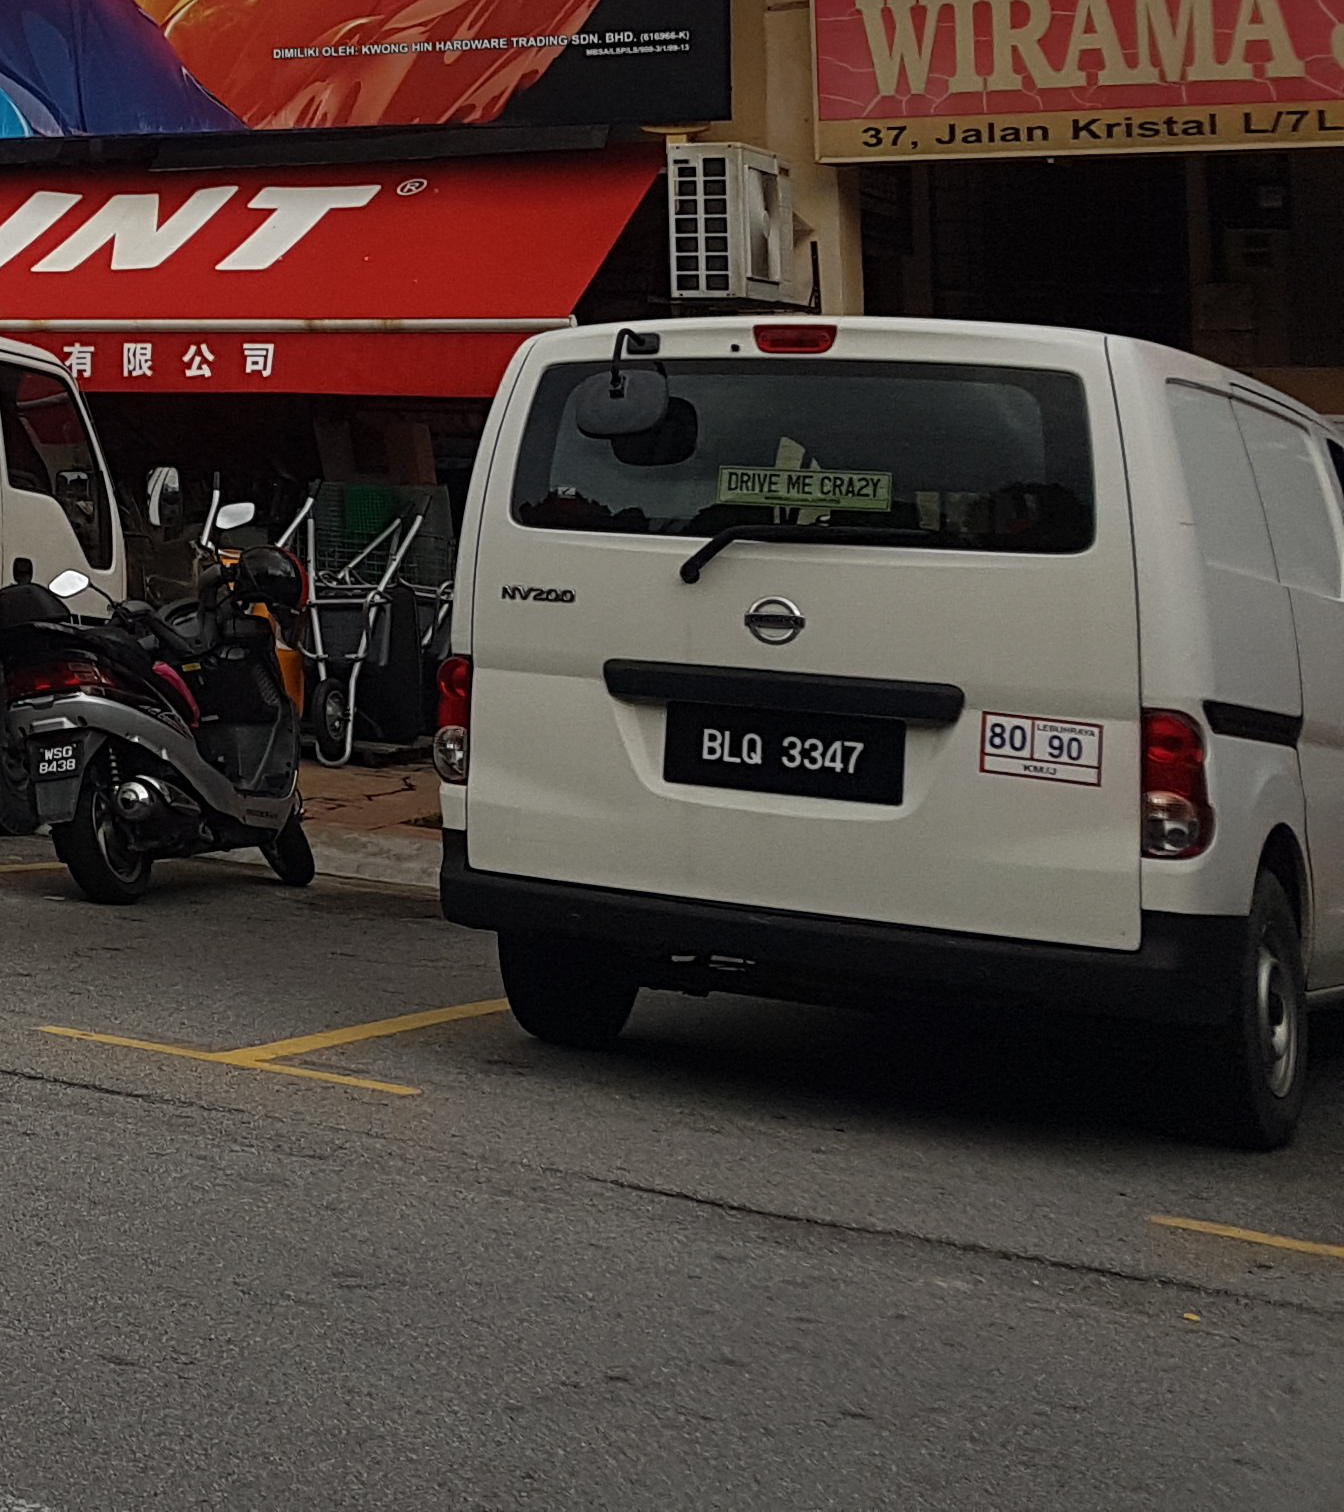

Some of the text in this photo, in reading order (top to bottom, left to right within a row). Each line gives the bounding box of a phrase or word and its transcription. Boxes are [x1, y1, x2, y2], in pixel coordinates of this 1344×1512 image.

[273, 31, 637, 60] DIMILIKI OLEH: KWONG HIN HARDWARE TRADING SDN. BHD.
[860, 113, 1218, 149] 37, Jalan Kristal
[63, 342, 275, 378] 有限公司
[728, 471, 813, 494] DRIVE ME
[501, 585, 575, 603] NV200
[989, 723, 1026, 751] 80
[1037, 724, 1095, 737] LEBUHRAYA
[44, 745, 74, 760] WSG
[702, 728, 864, 774] BLQ 3347
[1048, 735, 1082, 760] 90
[39, 758, 76, 774] 8438
